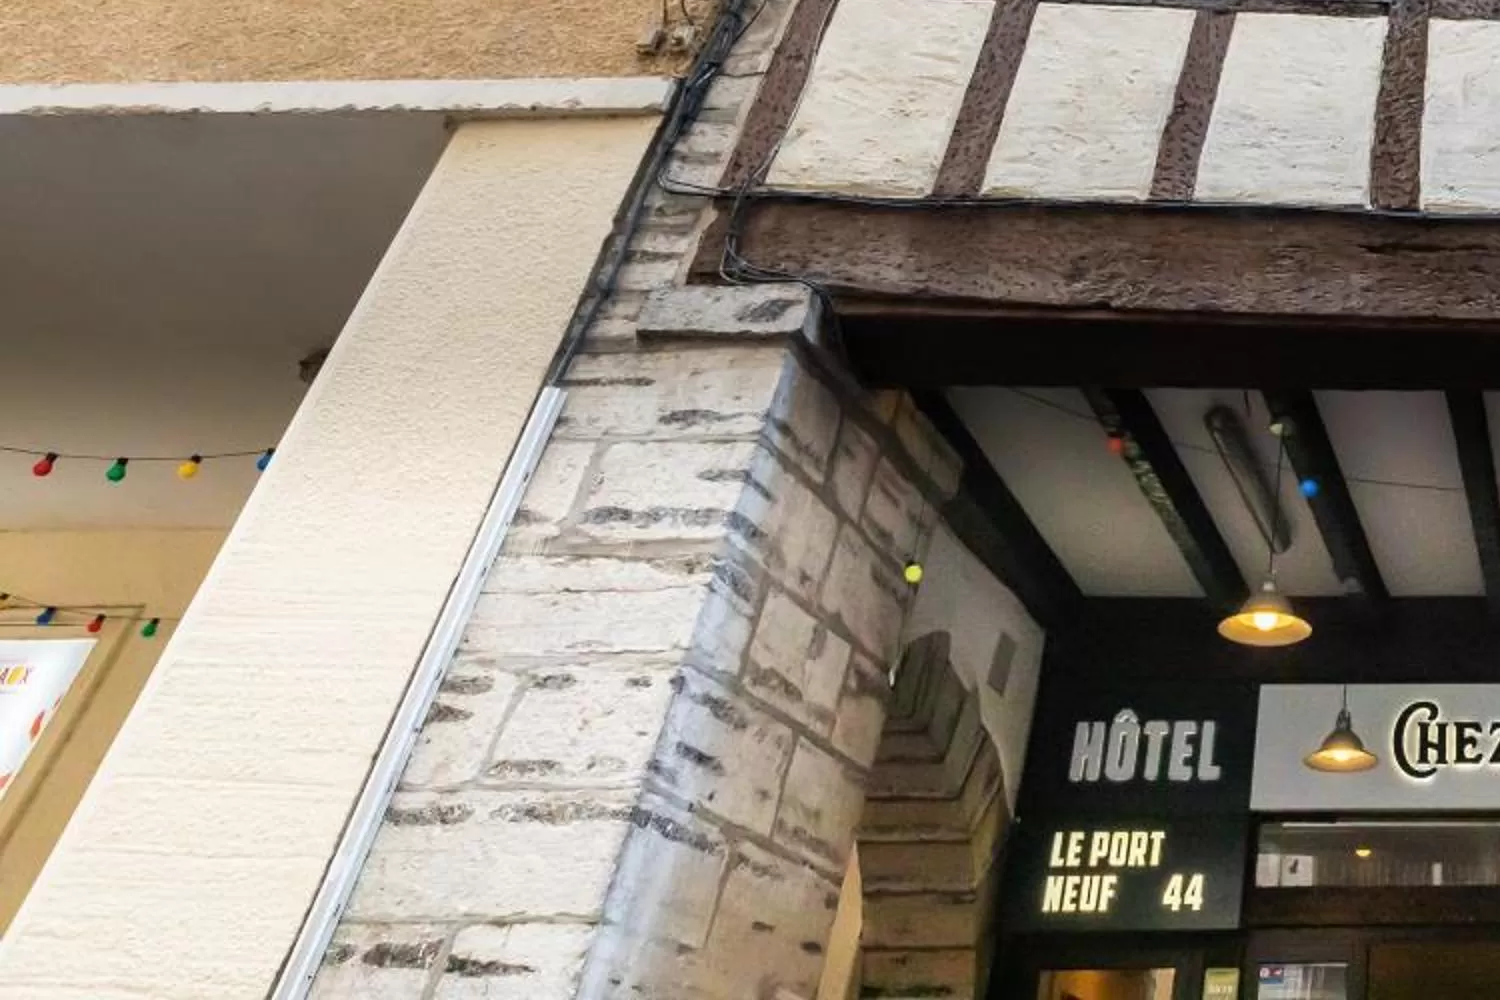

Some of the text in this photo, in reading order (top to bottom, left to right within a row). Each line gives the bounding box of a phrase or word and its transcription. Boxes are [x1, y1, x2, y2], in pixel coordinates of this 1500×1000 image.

[1068, 708, 1221, 782] HÔTEL
[1050, 831, 1166, 867] LE PORT
[1042, 873, 1205, 913] NEUF 44
